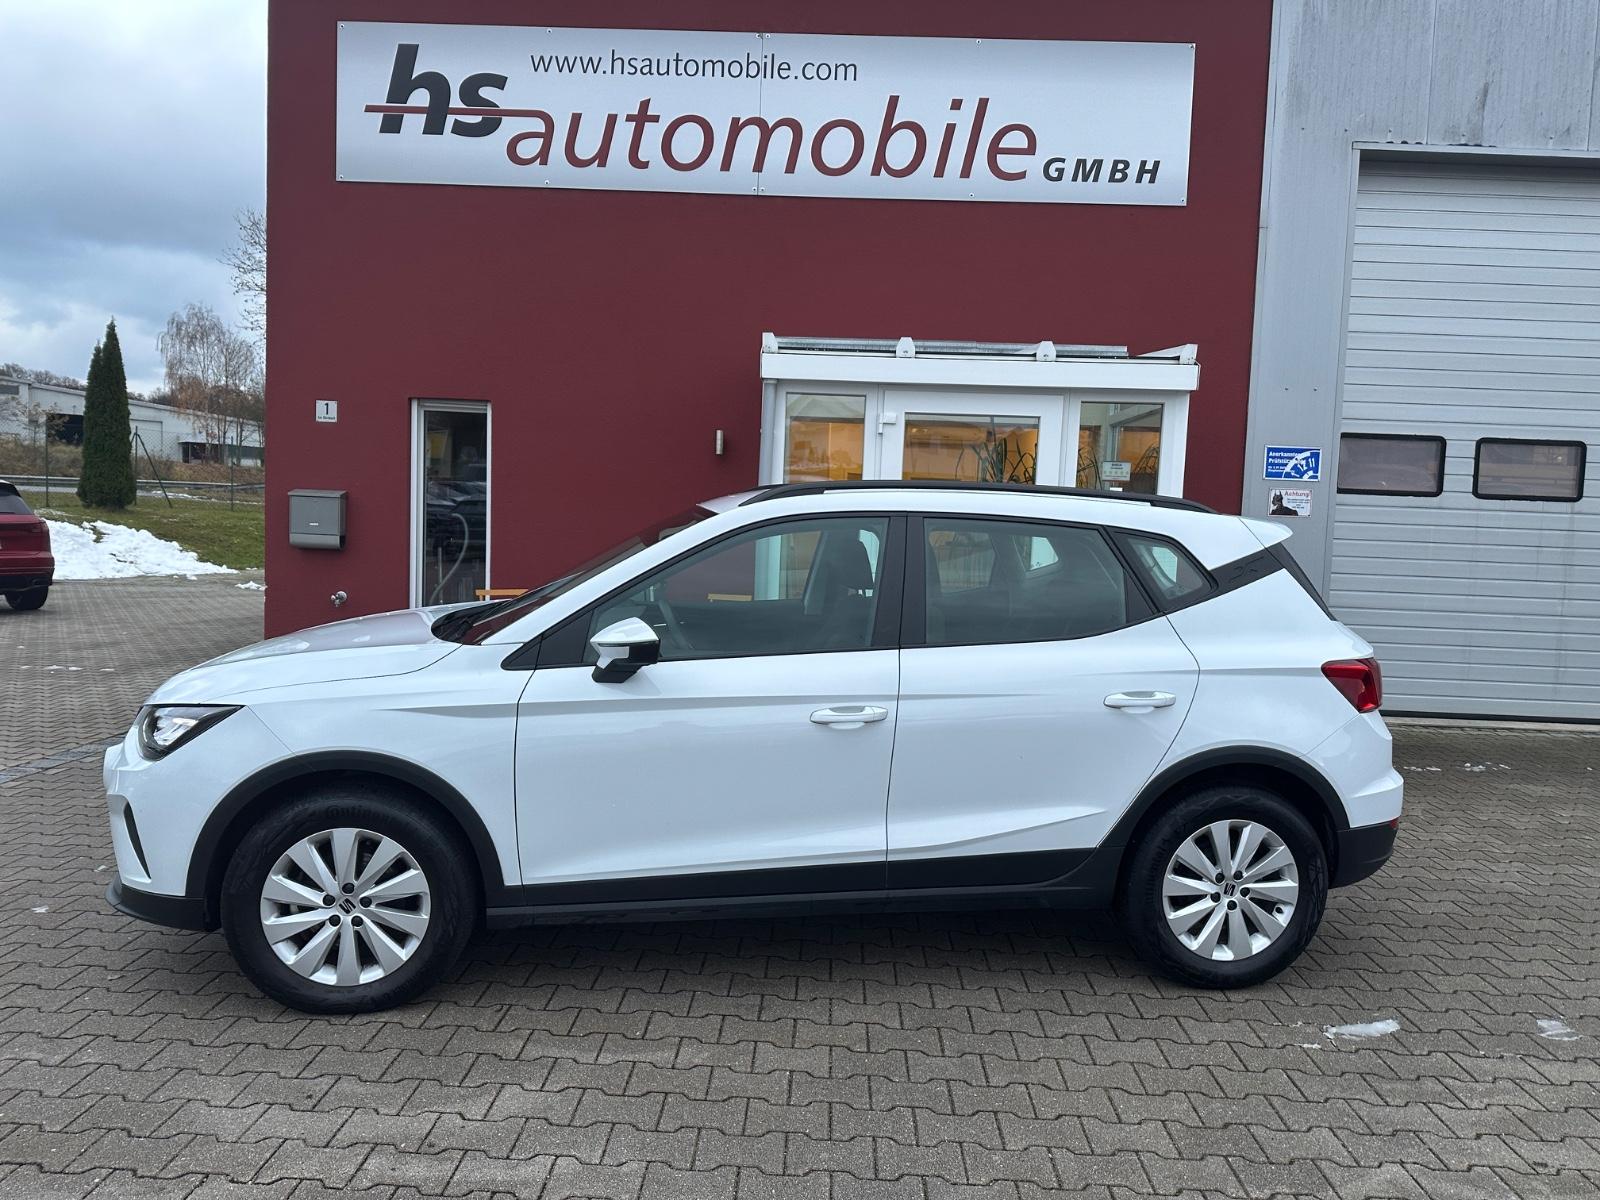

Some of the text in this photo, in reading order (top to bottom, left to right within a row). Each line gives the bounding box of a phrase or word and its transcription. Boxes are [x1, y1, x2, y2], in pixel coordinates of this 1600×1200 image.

[530, 49, 858, 82] www.hsautomobile.com
[378, 43, 1161, 185] hs automobile GMBH
[324, 402, 329, 415] 1
